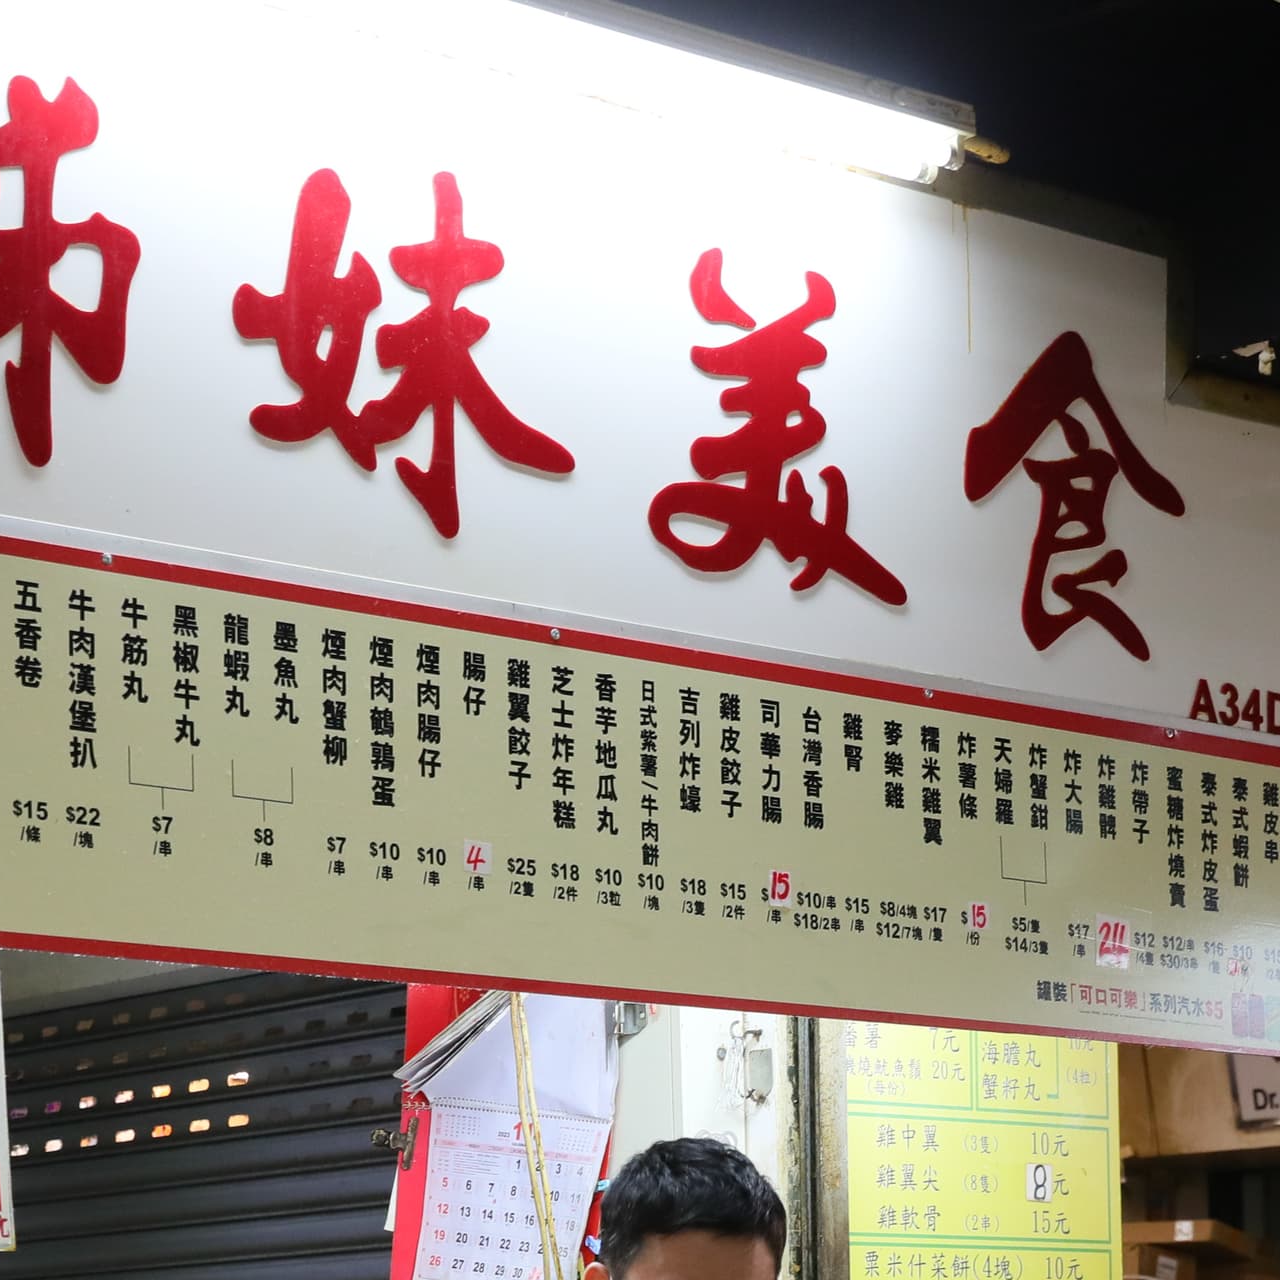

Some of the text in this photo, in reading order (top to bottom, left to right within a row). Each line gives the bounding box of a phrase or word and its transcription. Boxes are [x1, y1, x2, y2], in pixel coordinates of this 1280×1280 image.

[14, 580, 42, 688] 五香卷
[121, 598, 149, 703] 牛筋丸
[68, 589, 97, 769] 牛肉漢堡扒
[172, 605, 200, 747] 黑椒牛丸
[223, 613, 250, 718] 龍蝦丸
[273, 622, 299, 725] 墨魚丸
[463, 651, 486, 716] 腸仔
[322, 629, 348, 766] 煙肉蟹柳
[370, 636, 395, 808] 煙肉鵪鶉蛋
[417, 643, 441, 778] 煙肉腸仔
[508, 659, 531, 790] 雞翼餃子
[552, 666, 576, 829] 芝士炸年糕
[595, 673, 618, 835] 香芋地瓜丸
[679, 687, 701, 813] 吉列炸蠔
[720, 693, 742, 818] 雞皮餃子
[760, 699, 782, 824] 司華力腸
[802, 706, 824, 829] 台灣香腸
[843, 713, 863, 772] 雞腎
[884, 720, 904, 809] 麥樂雞
[640, 680, 659, 867] 日式紫薯/牛肉餅
[921, 726, 942, 845] 糯米雞翼
[957, 731, 978, 820] 炸薯條
[994, 737, 1014, 826] 天婦羅
[1029, 743, 1048, 830] 炸蟹鉗
[1063, 749, 1083, 835] 炸大腸
[1098, 754, 1116, 840] 炸雞髀
[1131, 760, 1150, 844] 炸帶子
[12, 800, 49, 820] $15
[66, 807, 101, 827] $22
[152, 817, 173, 835] $7
[254, 828, 274, 846] $8
[1166, 766, 1186, 912] 蜜糖炸燒賣
[1232, 777, 1250, 888] 泰式蝦餅
[1263, 782, 1279, 863] 雞皮串
[327, 836, 347, 854] $7
[369, 842, 400, 861] $10
[417, 847, 447, 866] $10
[466, 845, 486, 871] 4
[507, 858, 537, 876] $25
[1200, 772, 1219, 912] 泰式炸皮蛋
[551, 864, 580, 881] $18
[595, 868, 622, 887] $10
[638, 873, 665, 891] $10
[680, 878, 707, 896] $18
[720, 883, 747, 900] $15
[771, 871, 790, 900] 15
[797, 892, 837, 910] $10/串
[845, 898, 870, 914] $15
[923, 906, 947, 923] $17
[971, 904, 987, 929] 15
[1134, 932, 1155, 948] $12
[932, 1060, 965, 1081] 20元
[982, 1040, 1041, 1067] 海膽丸
[983, 1073, 1040, 1101] 蟹籽丸
[1253, 1087, 1280, 1111] Dr.
[877, 1124, 1069, 1157] 雞中翼 10元
[877, 1164, 940, 1192] 雞翼尖
[479, 1236, 529, 1252] 21 22 23
[878, 1205, 1070, 1235] 雞軟骨 15元
[429, 1255, 522, 1278] 26 27 28 30
[1046, 1257, 1084, 1280] 10元
